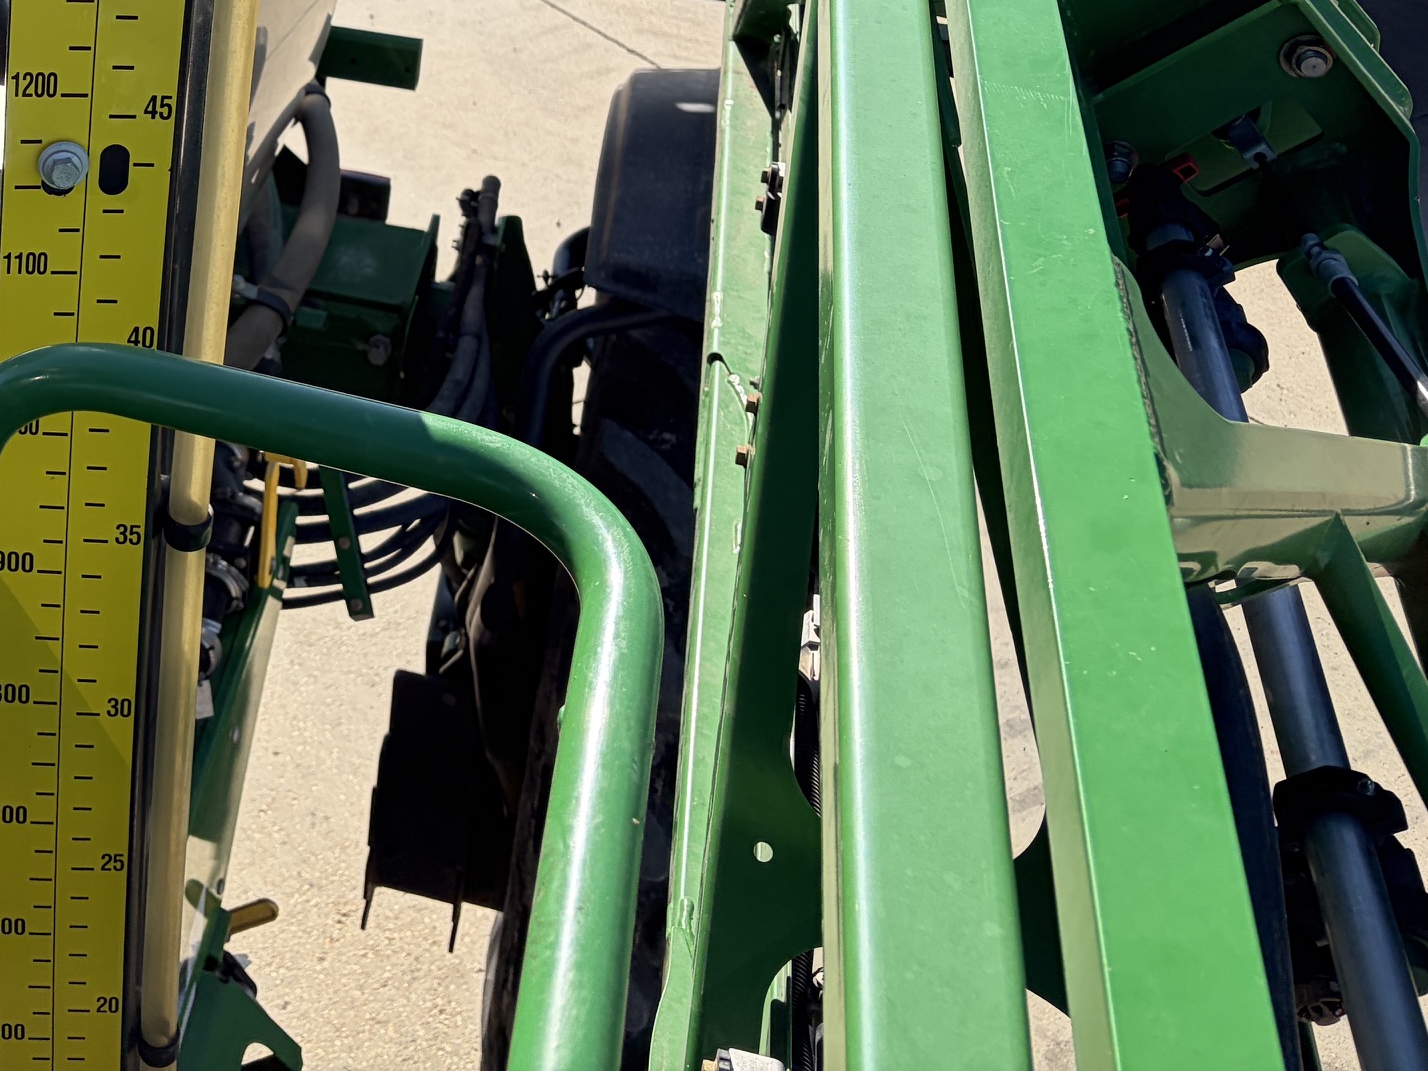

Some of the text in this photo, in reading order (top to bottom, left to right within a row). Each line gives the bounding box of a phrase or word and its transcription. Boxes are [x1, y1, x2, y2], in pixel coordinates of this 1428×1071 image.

[11, 72, 58, 98] 1200
[143, 95, 173, 121] 45
[3, 252, 47, 275] 1100
[127, 326, 155, 349] 40
[114, 524, 141, 545] 35
[106, 698, 132, 718] 30
[100, 854, 125, 872] 25
[96, 997, 119, 1014] 20
